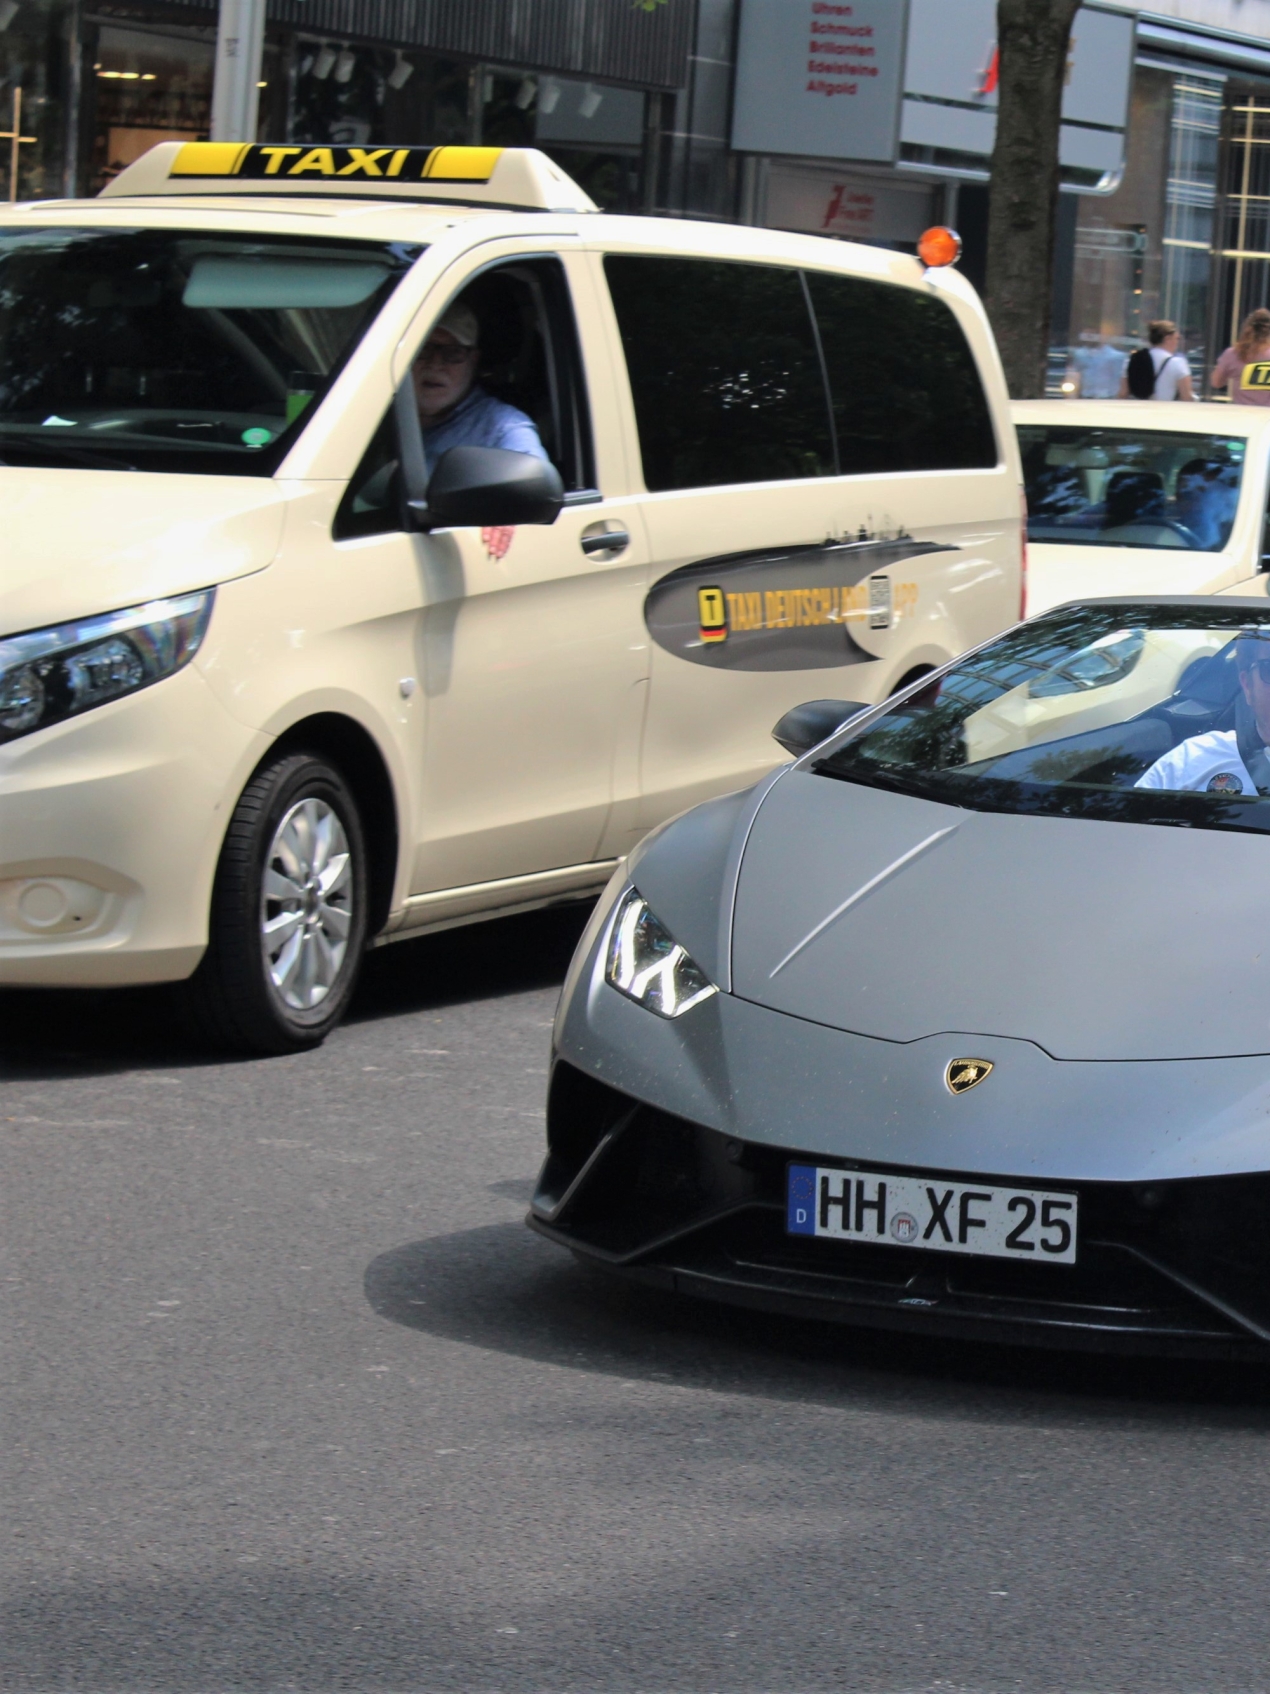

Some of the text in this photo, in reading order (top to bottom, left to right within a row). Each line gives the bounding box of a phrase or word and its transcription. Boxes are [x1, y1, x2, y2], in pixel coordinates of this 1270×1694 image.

[810, 21, 874, 37] Schmuck
[808, 40, 875, 57] Brillanten
[806, 60, 879, 78] Edelsteine
[259, 147, 411, 176] TAXI
[726, 592, 763, 632] TAXI
[796, 1208, 807, 1224] D
[819, 1175, 1073, 1254] HH XF 25
